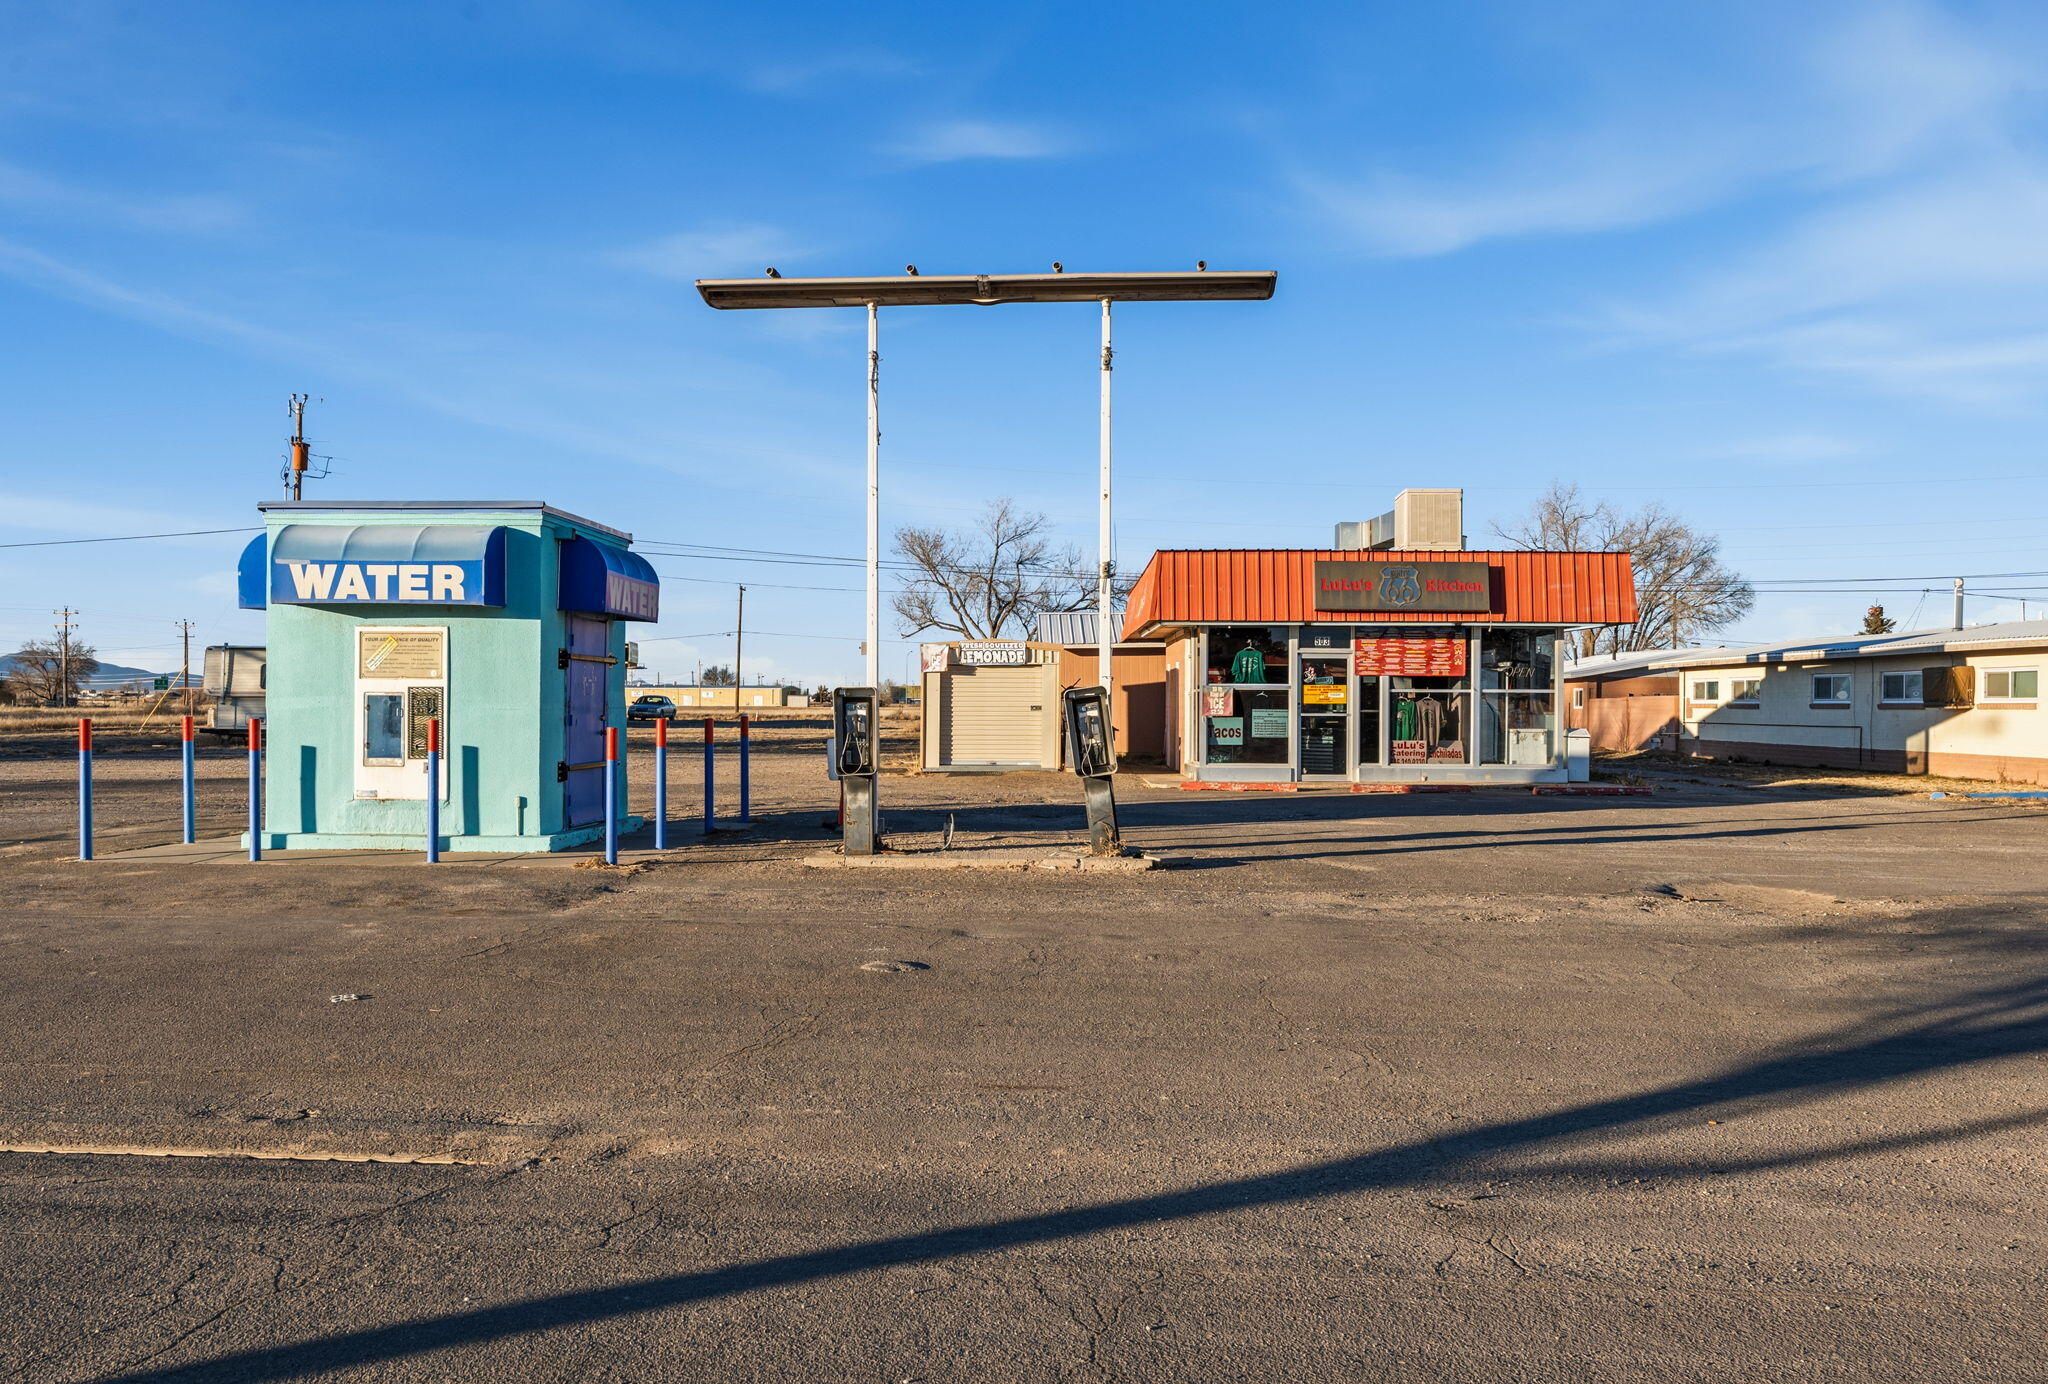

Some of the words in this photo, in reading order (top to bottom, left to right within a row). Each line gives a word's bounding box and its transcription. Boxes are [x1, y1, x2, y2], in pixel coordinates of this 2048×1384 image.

[289, 564, 466, 601] WATER
[1321, 578, 1374, 591] LuLu's
[1426, 579, 1484, 592] Kitchen
[1386, 577, 1414, 601] 66
[607, 574, 658, 618] WATER
[1315, 637, 1329, 646] 503
[960, 649, 1024, 664] LEMONADE
[1506, 666, 1536, 678] OPEN
[1209, 697, 1225, 709] ICE
[1391, 740, 1425, 750] LuLu's
[1391, 749, 1426, 758] Catering
